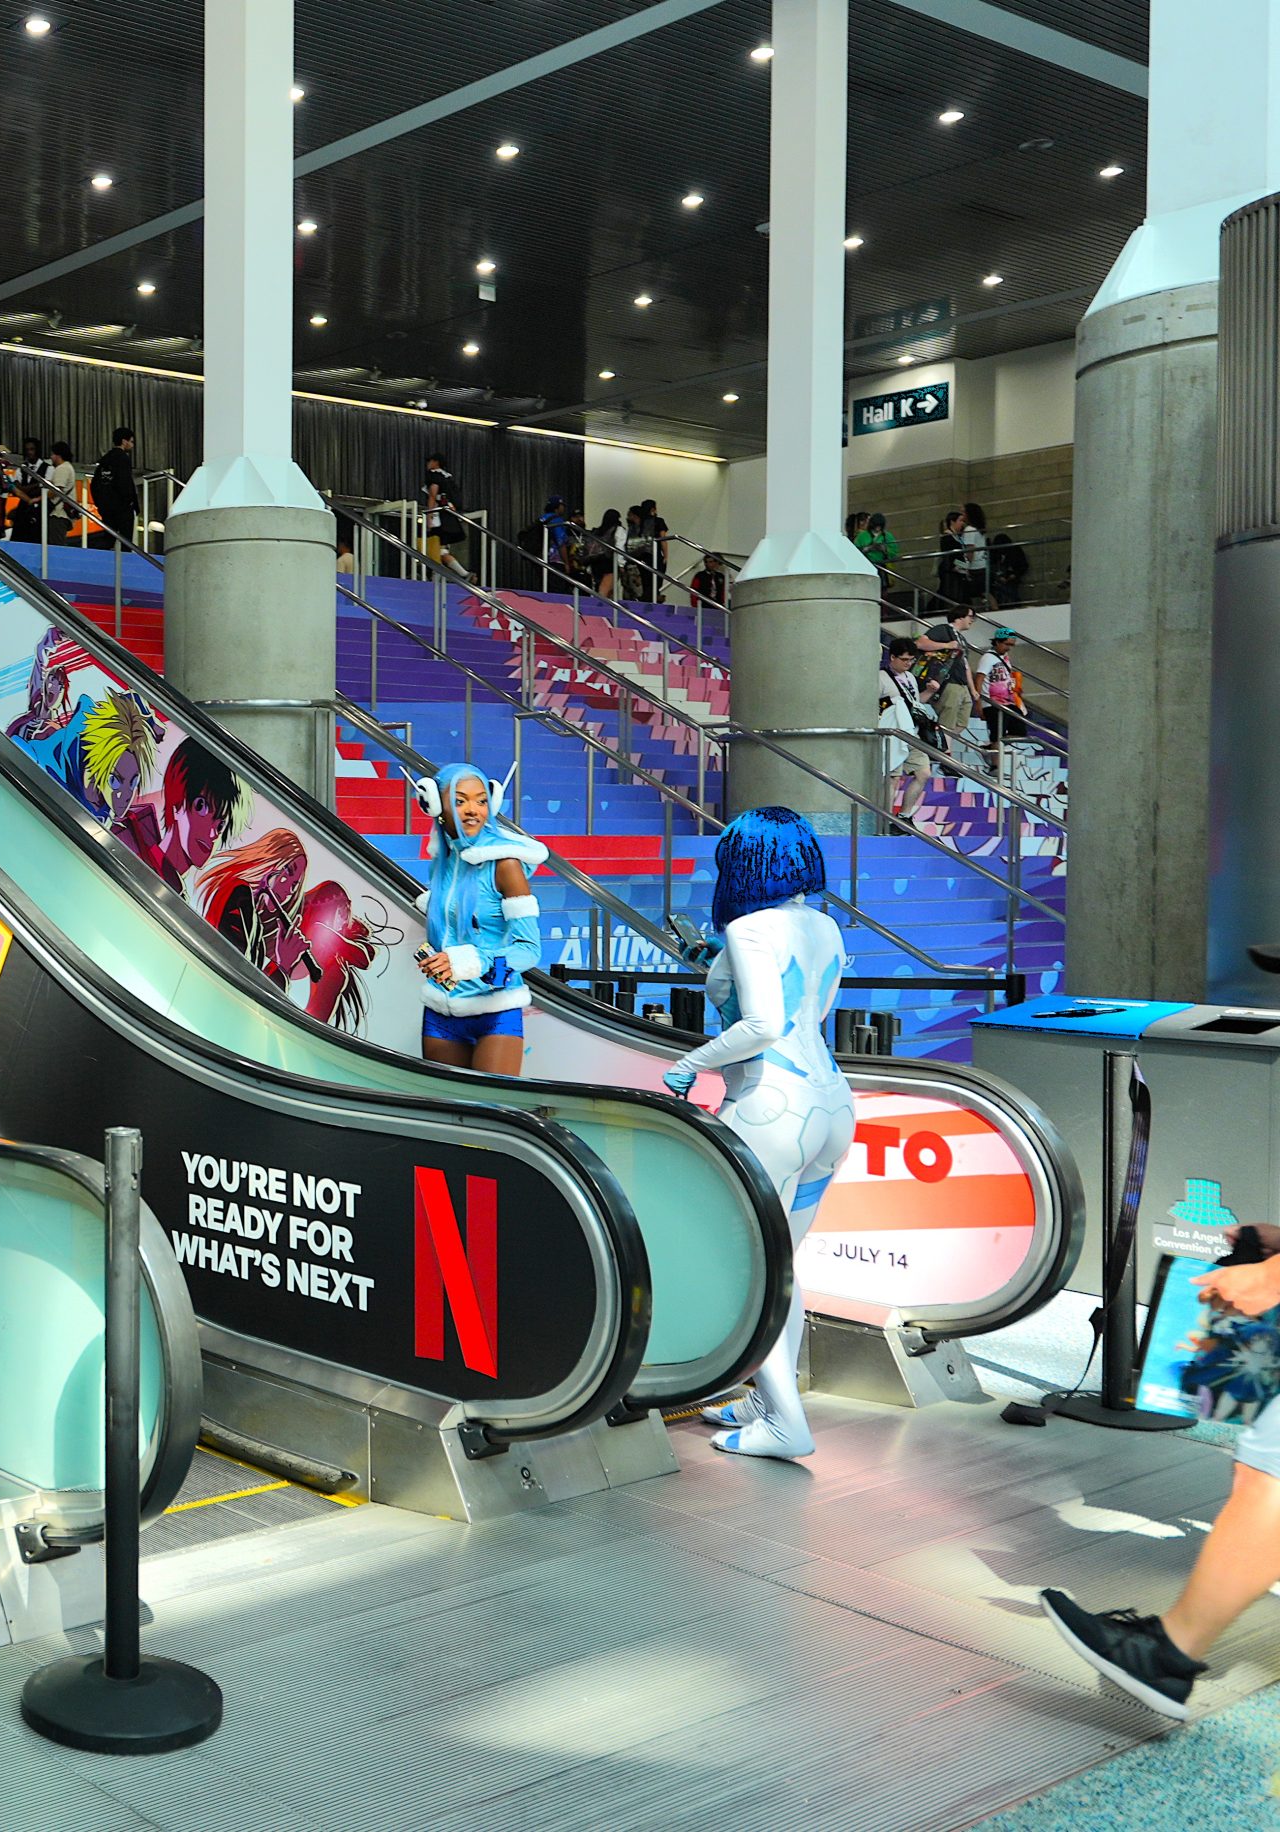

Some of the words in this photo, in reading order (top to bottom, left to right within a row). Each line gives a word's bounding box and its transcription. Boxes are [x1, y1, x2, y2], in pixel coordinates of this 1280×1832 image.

[862, 401, 894, 425] Hall
[900, 397, 914, 418] K
[181, 1151, 286, 1204] YOU'RE
[293, 1173, 361, 1218] NOT
[189, 1194, 283, 1244] READY
[289, 1215, 354, 1263] FOR
[1172, 1227, 1190, 1239] Los
[1192, 1230, 1228, 1245] Angele
[833, 1243, 880, 1264] JULY
[888, 1252, 909, 1269] 14
[1154, 1236, 1211, 1254] Convention
[172, 1230, 281, 1288] WHAT'S
[287, 1259, 374, 1311] NEXT
